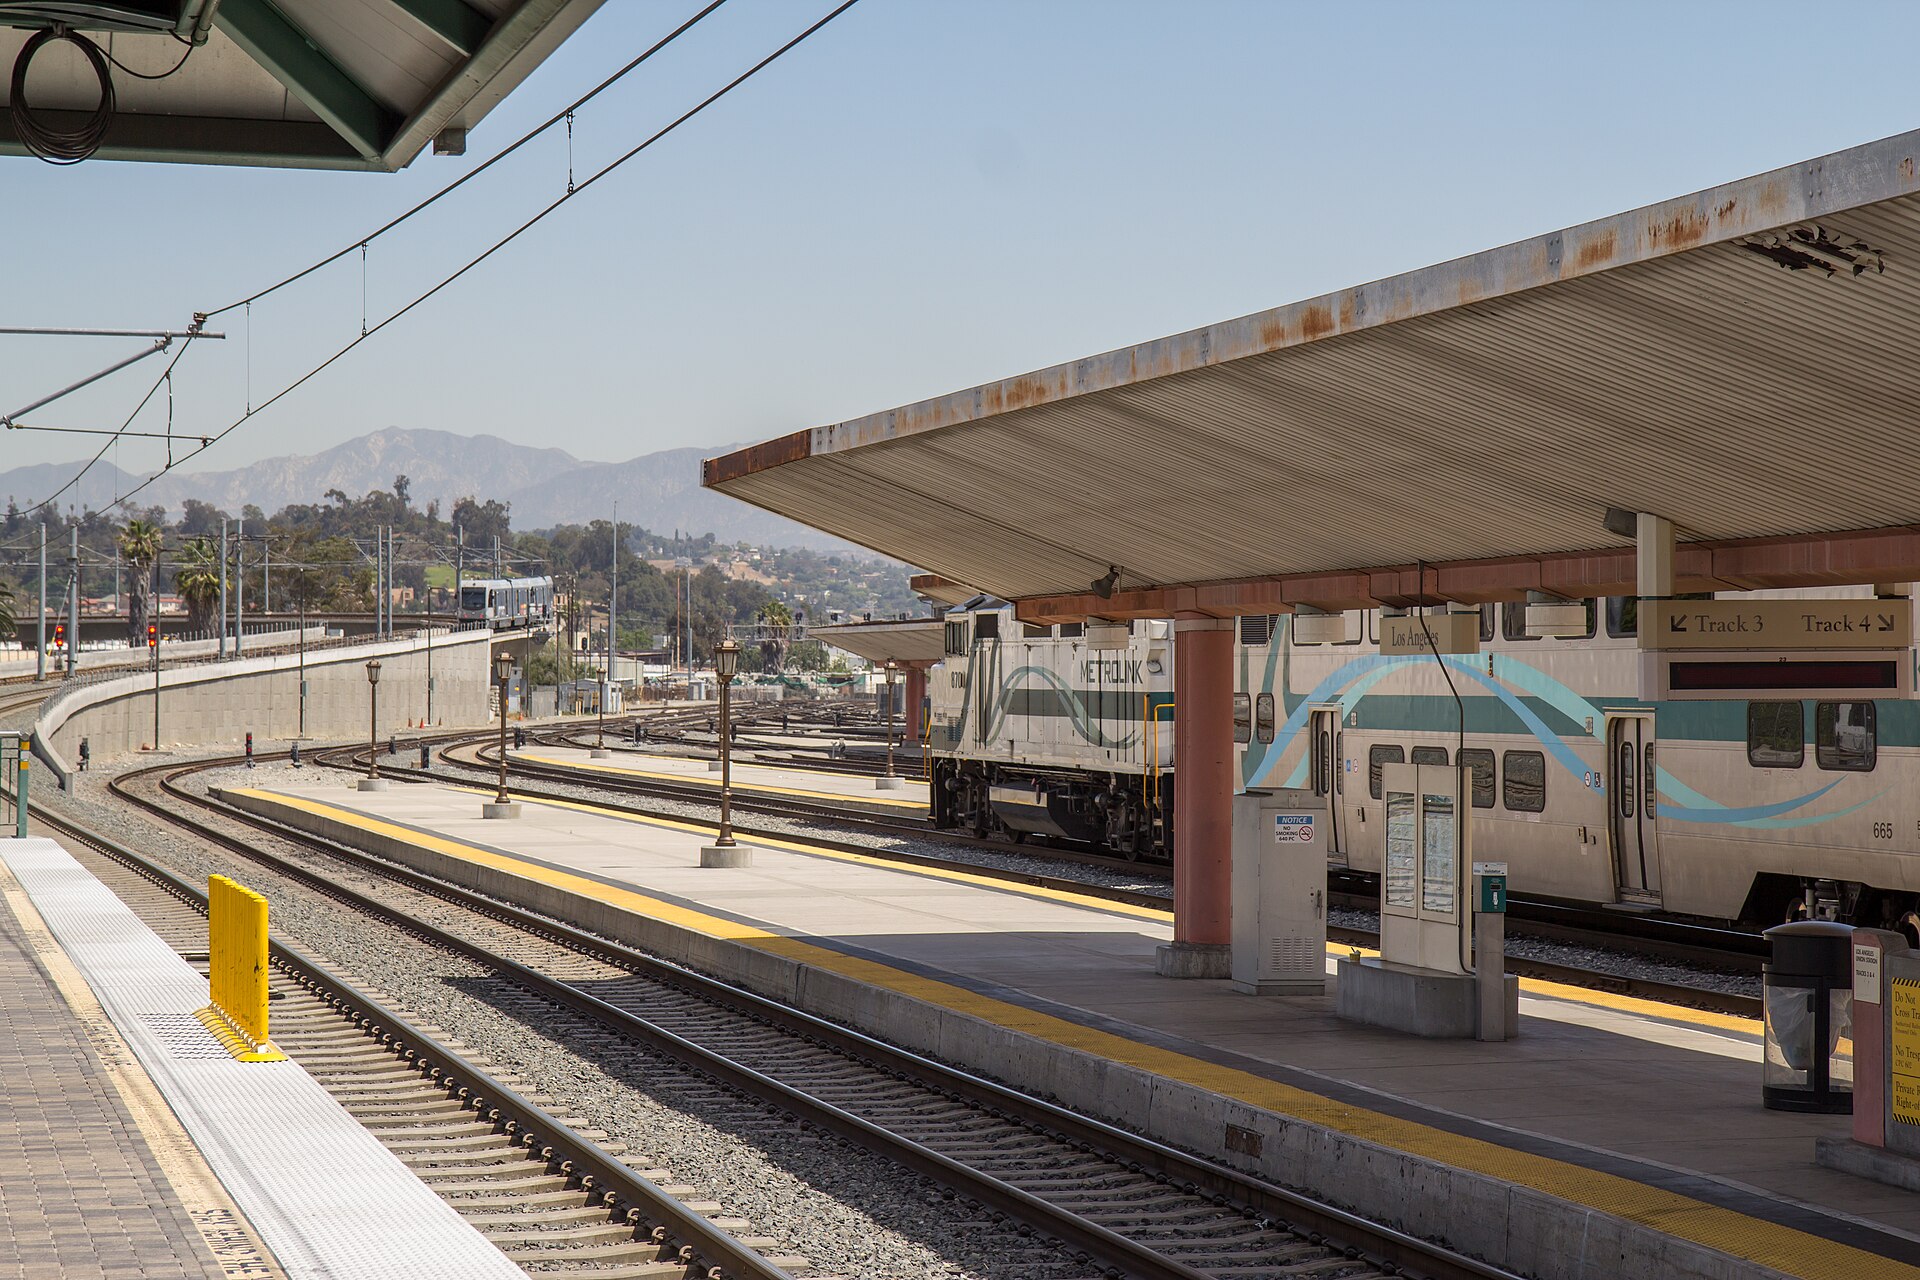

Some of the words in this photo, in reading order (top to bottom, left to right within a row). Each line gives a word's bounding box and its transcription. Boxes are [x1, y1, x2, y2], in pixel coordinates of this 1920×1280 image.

[1694, 614, 1749, 632] Track
[1752, 614, 1764, 632] 3
[1801, 614, 1853, 632] Track
[1858, 615, 1871, 633] 4
[1391, 626, 1406, 646] Los
[1407, 624, 1439, 651] Angeles
[1080, 660, 1143, 684] METROLINK
[1873, 822, 1893, 839] 665
[1895, 991, 1903, 1003] Do
[1905, 992, 1916, 1005] Not
[1895, 1005, 1910, 1018] Cross
[1895, 1044, 1904, 1056] No
[1895, 1081, 1915, 1095] Private
